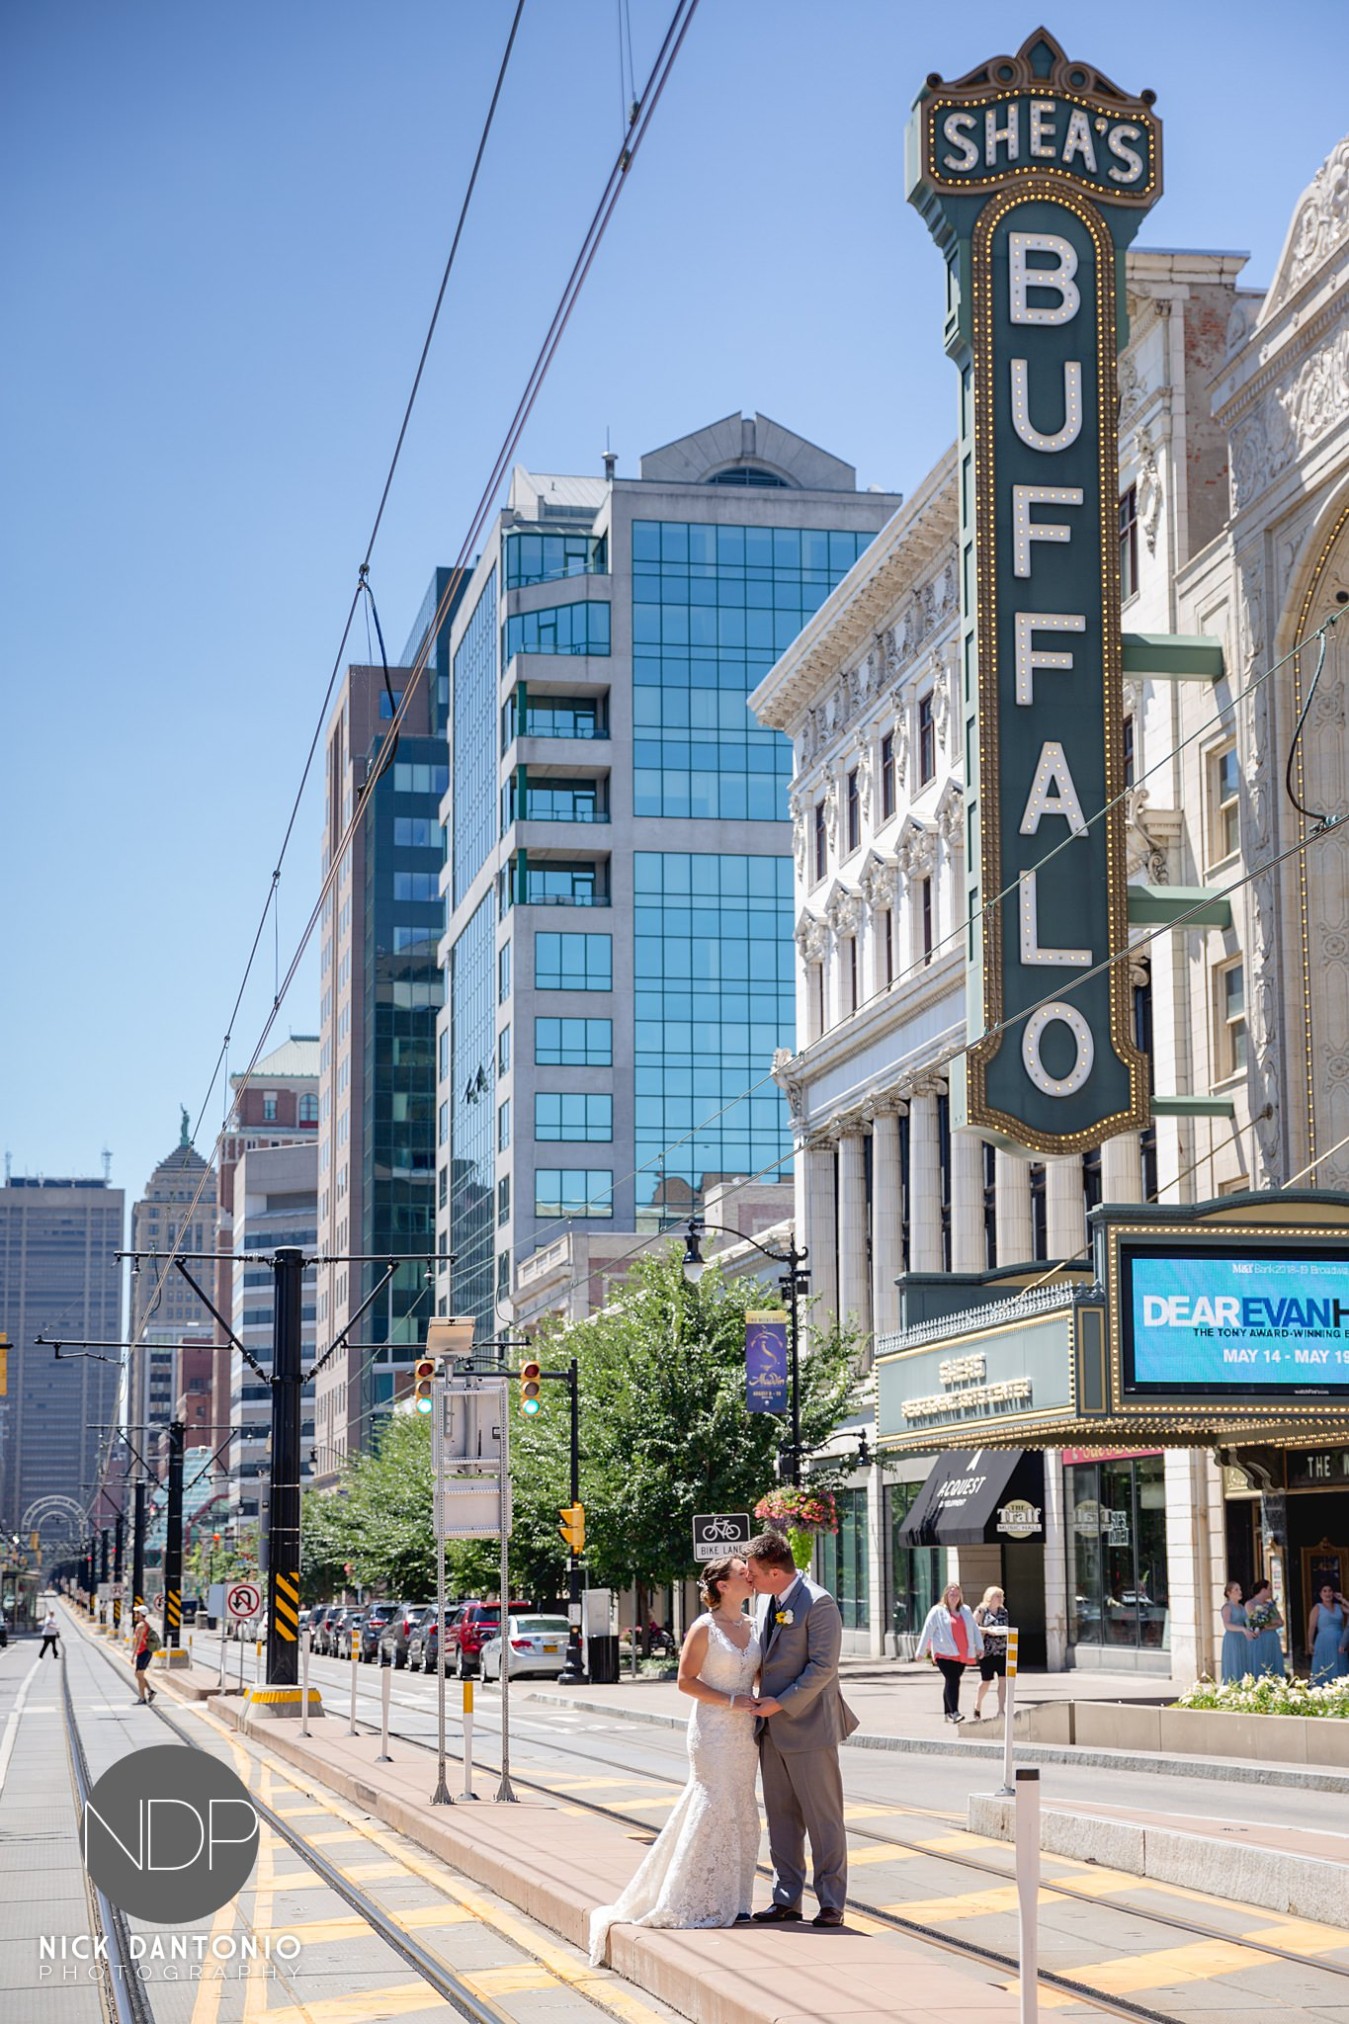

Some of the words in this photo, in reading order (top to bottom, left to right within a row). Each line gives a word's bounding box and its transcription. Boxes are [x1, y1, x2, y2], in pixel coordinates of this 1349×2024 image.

[943, 100, 1144, 184] SHEA'S
[1008, 231, 1094, 1098] BUFFALO
[1143, 1295, 1240, 1327] DEAR
[1241, 1297, 1331, 1328] EVAN
[1193, 1328, 1214, 1337] THE
[1218, 1328, 1247, 1337] TONY
[1249, 1328, 1341, 1338] AWARD-WINNING
[1223, 1350, 1258, 1363] MAY
[1263, 1350, 1281, 1363] 14
[1294, 1350, 1331, 1364] MAY
[1307, 1455, 1331, 1478] THE
[937, 1476, 987, 1497] ACQUEST
[997, 1507, 1042, 1523] Tralf
[701, 1546, 719, 1556] BIKE
